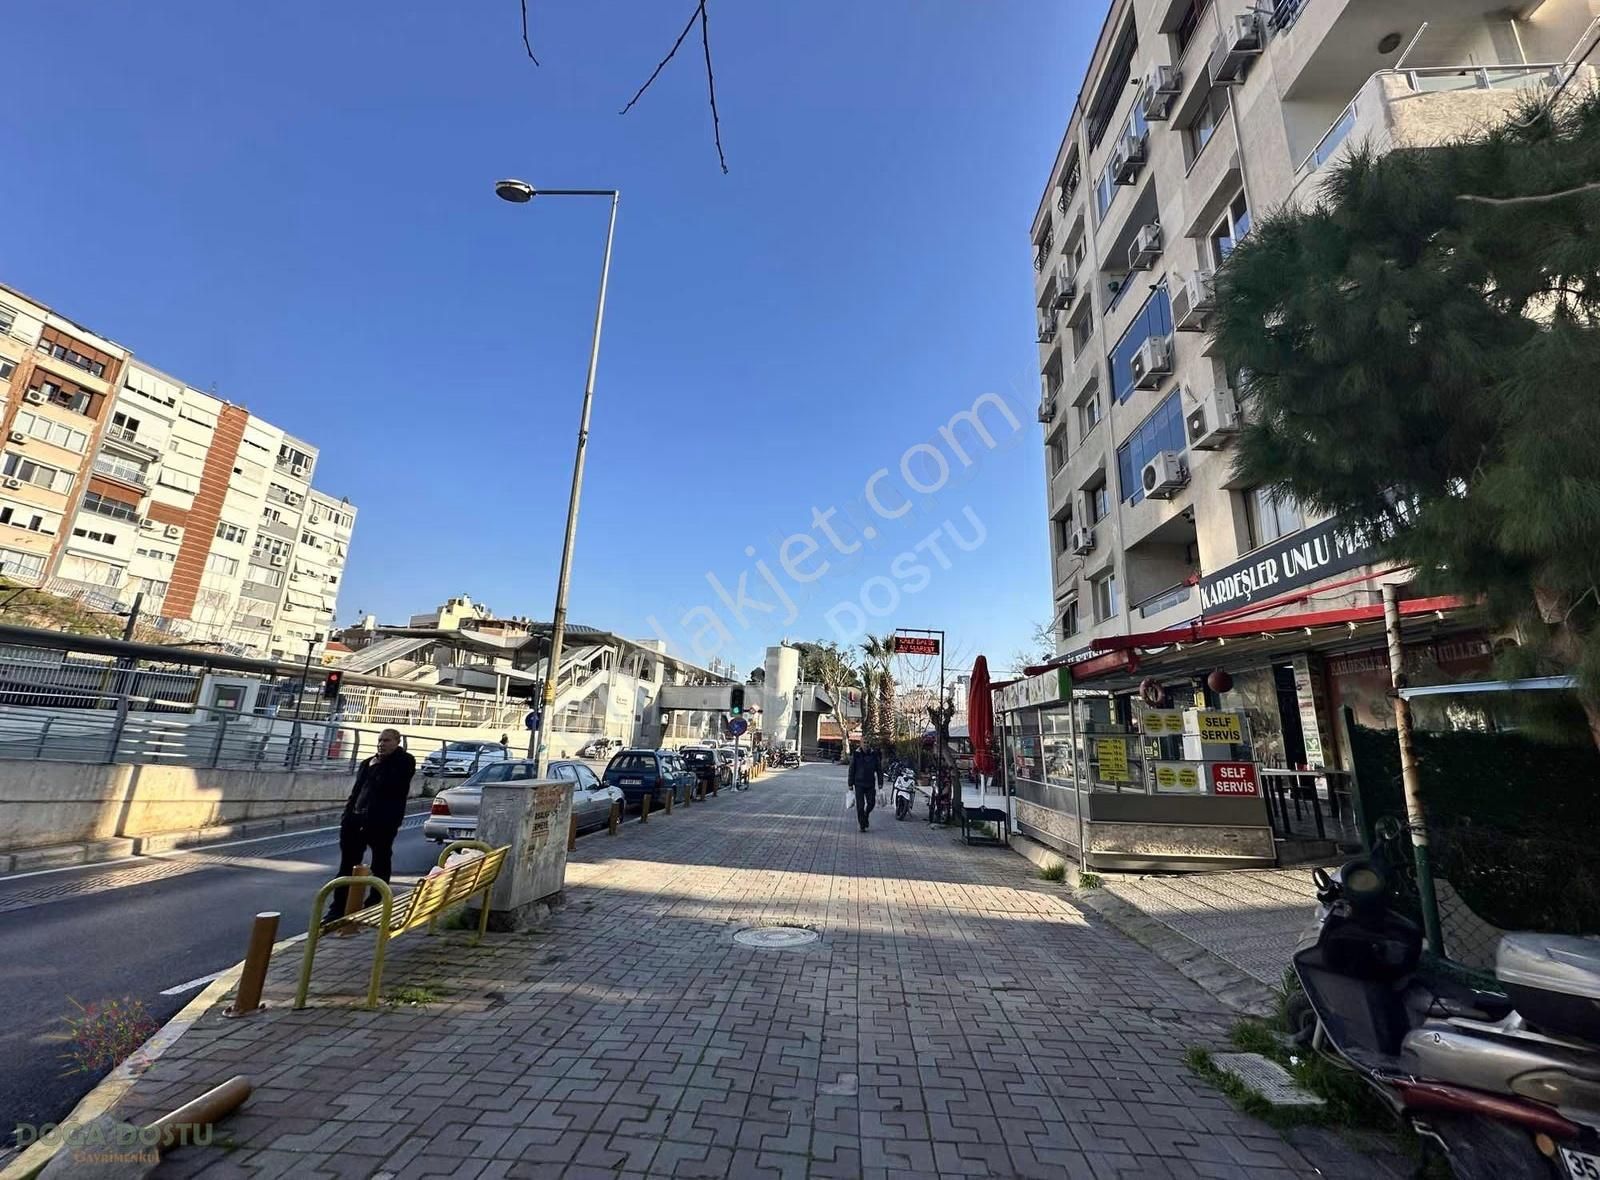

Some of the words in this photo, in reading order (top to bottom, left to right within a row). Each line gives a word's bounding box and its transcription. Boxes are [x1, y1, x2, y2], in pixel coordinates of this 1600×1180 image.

[1200, 558, 1279, 601] KARDEŞLER
[1282, 533, 1330, 578] UNLU
[1205, 717, 1231, 727] SELF
[1201, 729, 1240, 740] SERVİS
[1220, 767, 1246, 778] SELF
[1216, 780, 1255, 793] SERVİS
[1568, 1152, 1600, 1180] 35
